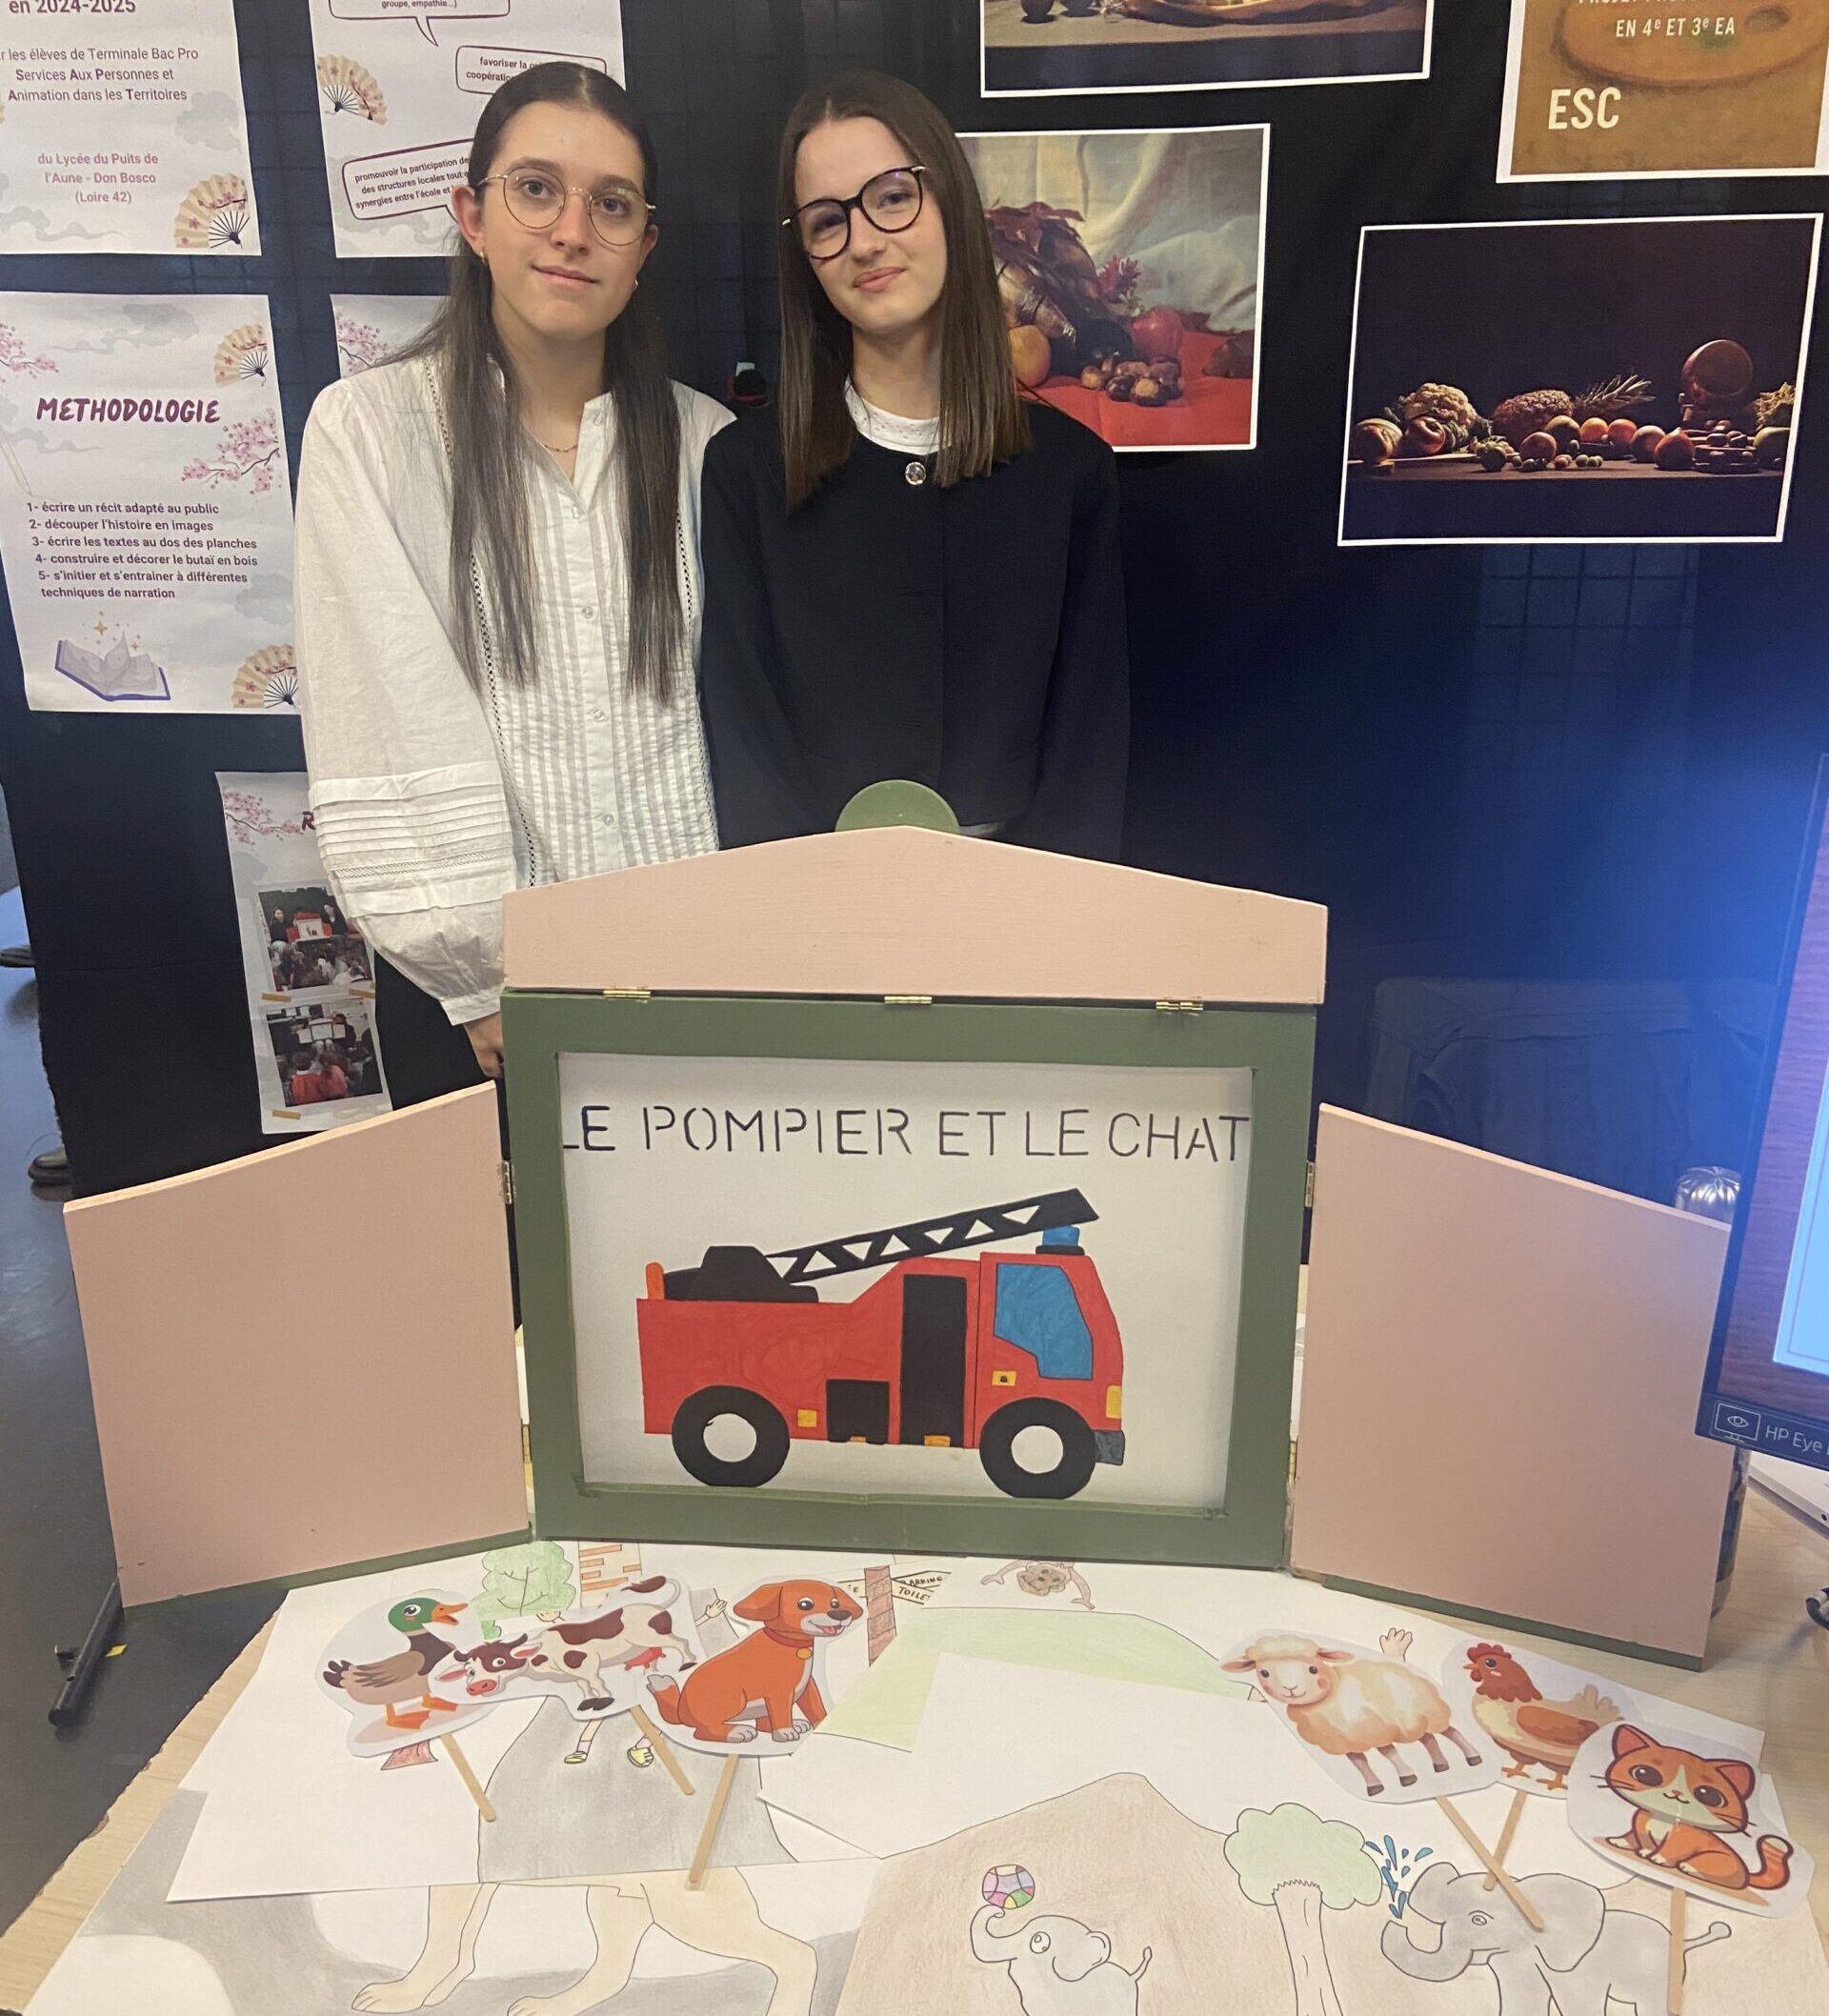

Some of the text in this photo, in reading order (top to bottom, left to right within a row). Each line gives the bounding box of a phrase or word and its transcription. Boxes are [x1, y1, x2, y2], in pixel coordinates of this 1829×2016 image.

[10, 0, 136, 13] en 2024-2025
[1616, 19, 1637, 37] EN
[1666, 17, 1686, 36] ET
[1715, 17, 1735, 35] EA
[9, 48, 26, 61] les
[30, 48, 67, 60] élèves
[70, 48, 85, 60] de
[88, 48, 149, 60] Terminale
[151, 48, 174, 60] Bac
[178, 48, 198, 60] Pro
[480, 56, 517, 68] favoriser
[15, 68, 173, 81] Services Aux Personnes et
[466, 71, 513, 81] coopératio
[8, 88, 187, 101] Animation dans les Territoires
[1548, 87, 1620, 130] ESC
[38, 153, 158, 167] du Lycée du Puits de
[355, 167, 398, 183] promouvoir
[410, 158, 457, 174] participation
[45, 172, 83, 184] l'Aune
[94, 172, 117, 184] Don
[120, 172, 156, 184] Bosco
[362, 186, 375, 194] des
[377, 179, 416, 192] structures
[418, 174, 445, 185] locales
[447, 171, 462, 180] tout
[75, 192, 131, 204] (Loire 42)
[356, 196, 392, 210] synergies
[395, 192, 414, 202] entre
[416, 188, 441, 199] l'école
[37, 398, 221, 423] METHODOLOGIE
[27, 501, 219, 515] 1- écrire un récit adapté au public
[30, 518, 213, 533] 2- découper l'histoire en images
[32, 535, 257, 549] 3- écrire les textes au dos des planches
[35, 553, 47, 563] 4-
[50, 553, 110, 564] construire
[112, 554, 123, 564] et
[126, 553, 171, 564] décorer
[173, 554, 183, 564] le
[217, 555, 231, 565] en
[234, 554, 258, 565] bois
[38, 570, 50, 579] 5-
[53, 570, 96, 580] s'initier
[100, 571, 111, 580] et
[176, 571, 184, 581] à
[187, 571, 248, 582] différentes
[41, 587, 175, 599] techniques de narration
[563, 1105, 1250, 1162] E POMPIER ET LE CHAT
[1765, 1425, 1789, 1440] HP
[1793, 1432, 1821, 1452] Eye
